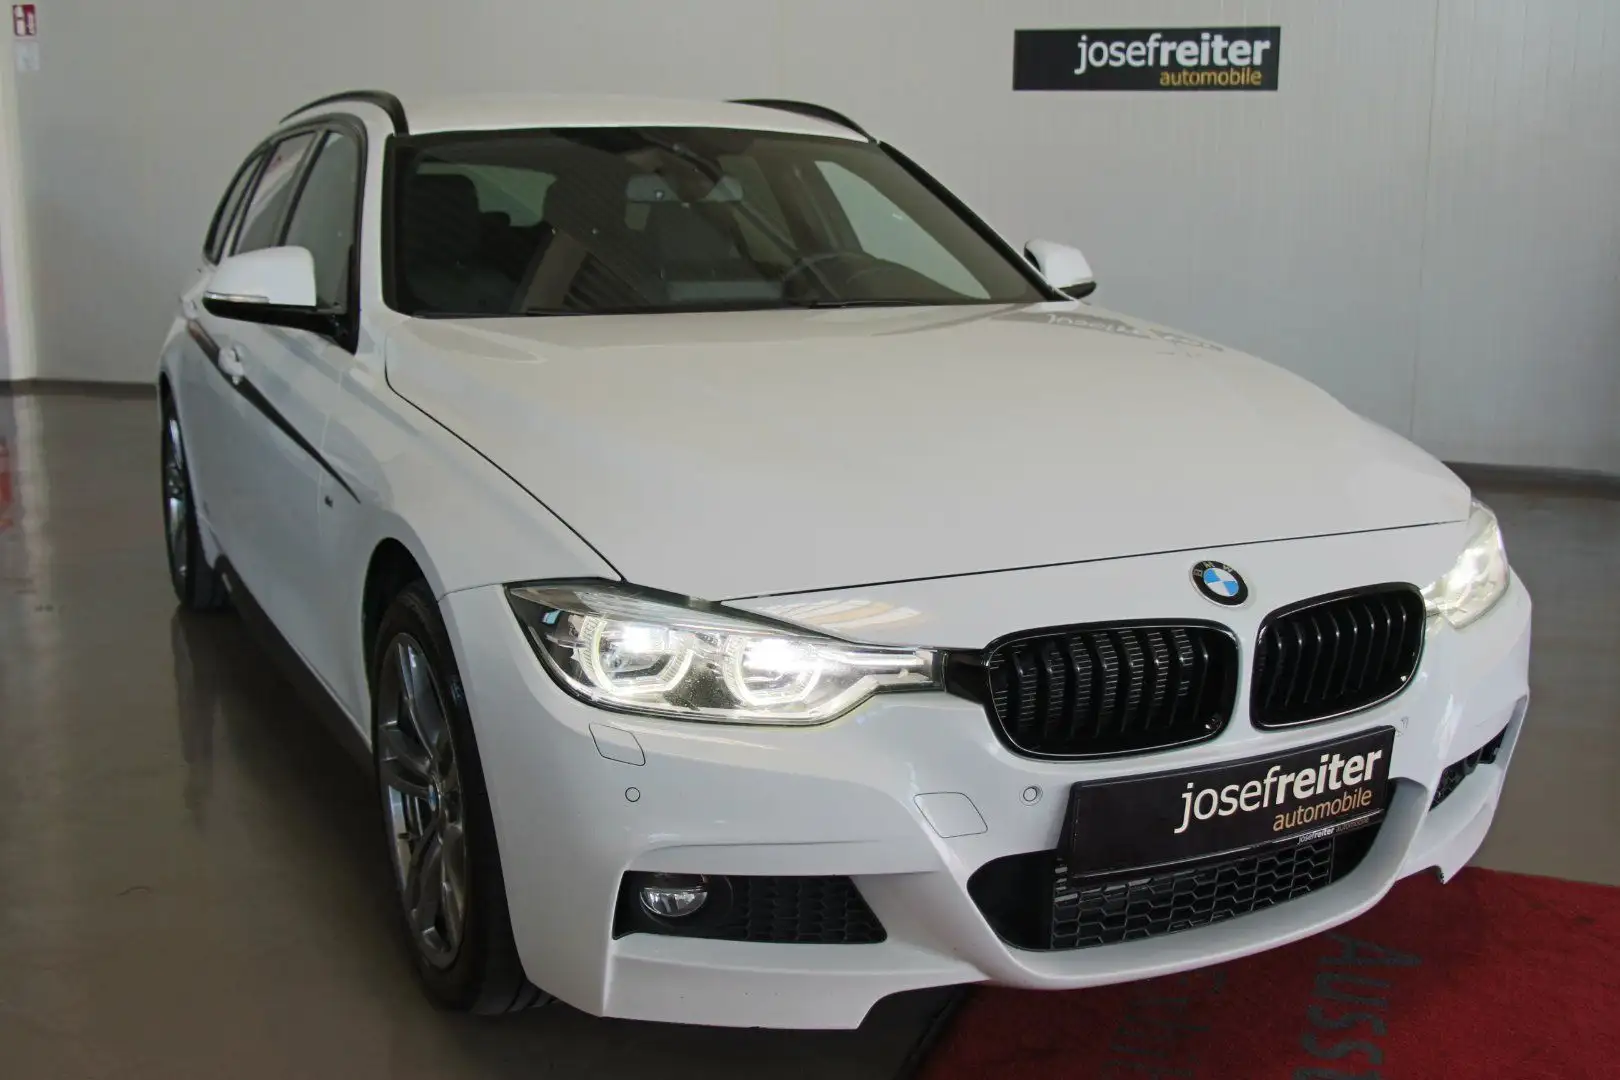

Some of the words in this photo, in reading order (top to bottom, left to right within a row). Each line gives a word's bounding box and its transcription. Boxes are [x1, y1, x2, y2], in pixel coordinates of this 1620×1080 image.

[1074, 33, 1271, 75] josefreiter
[1159, 67, 1262, 86] automobile
[1174, 750, 1382, 834] josefreiter
[1273, 788, 1372, 831] automobile
